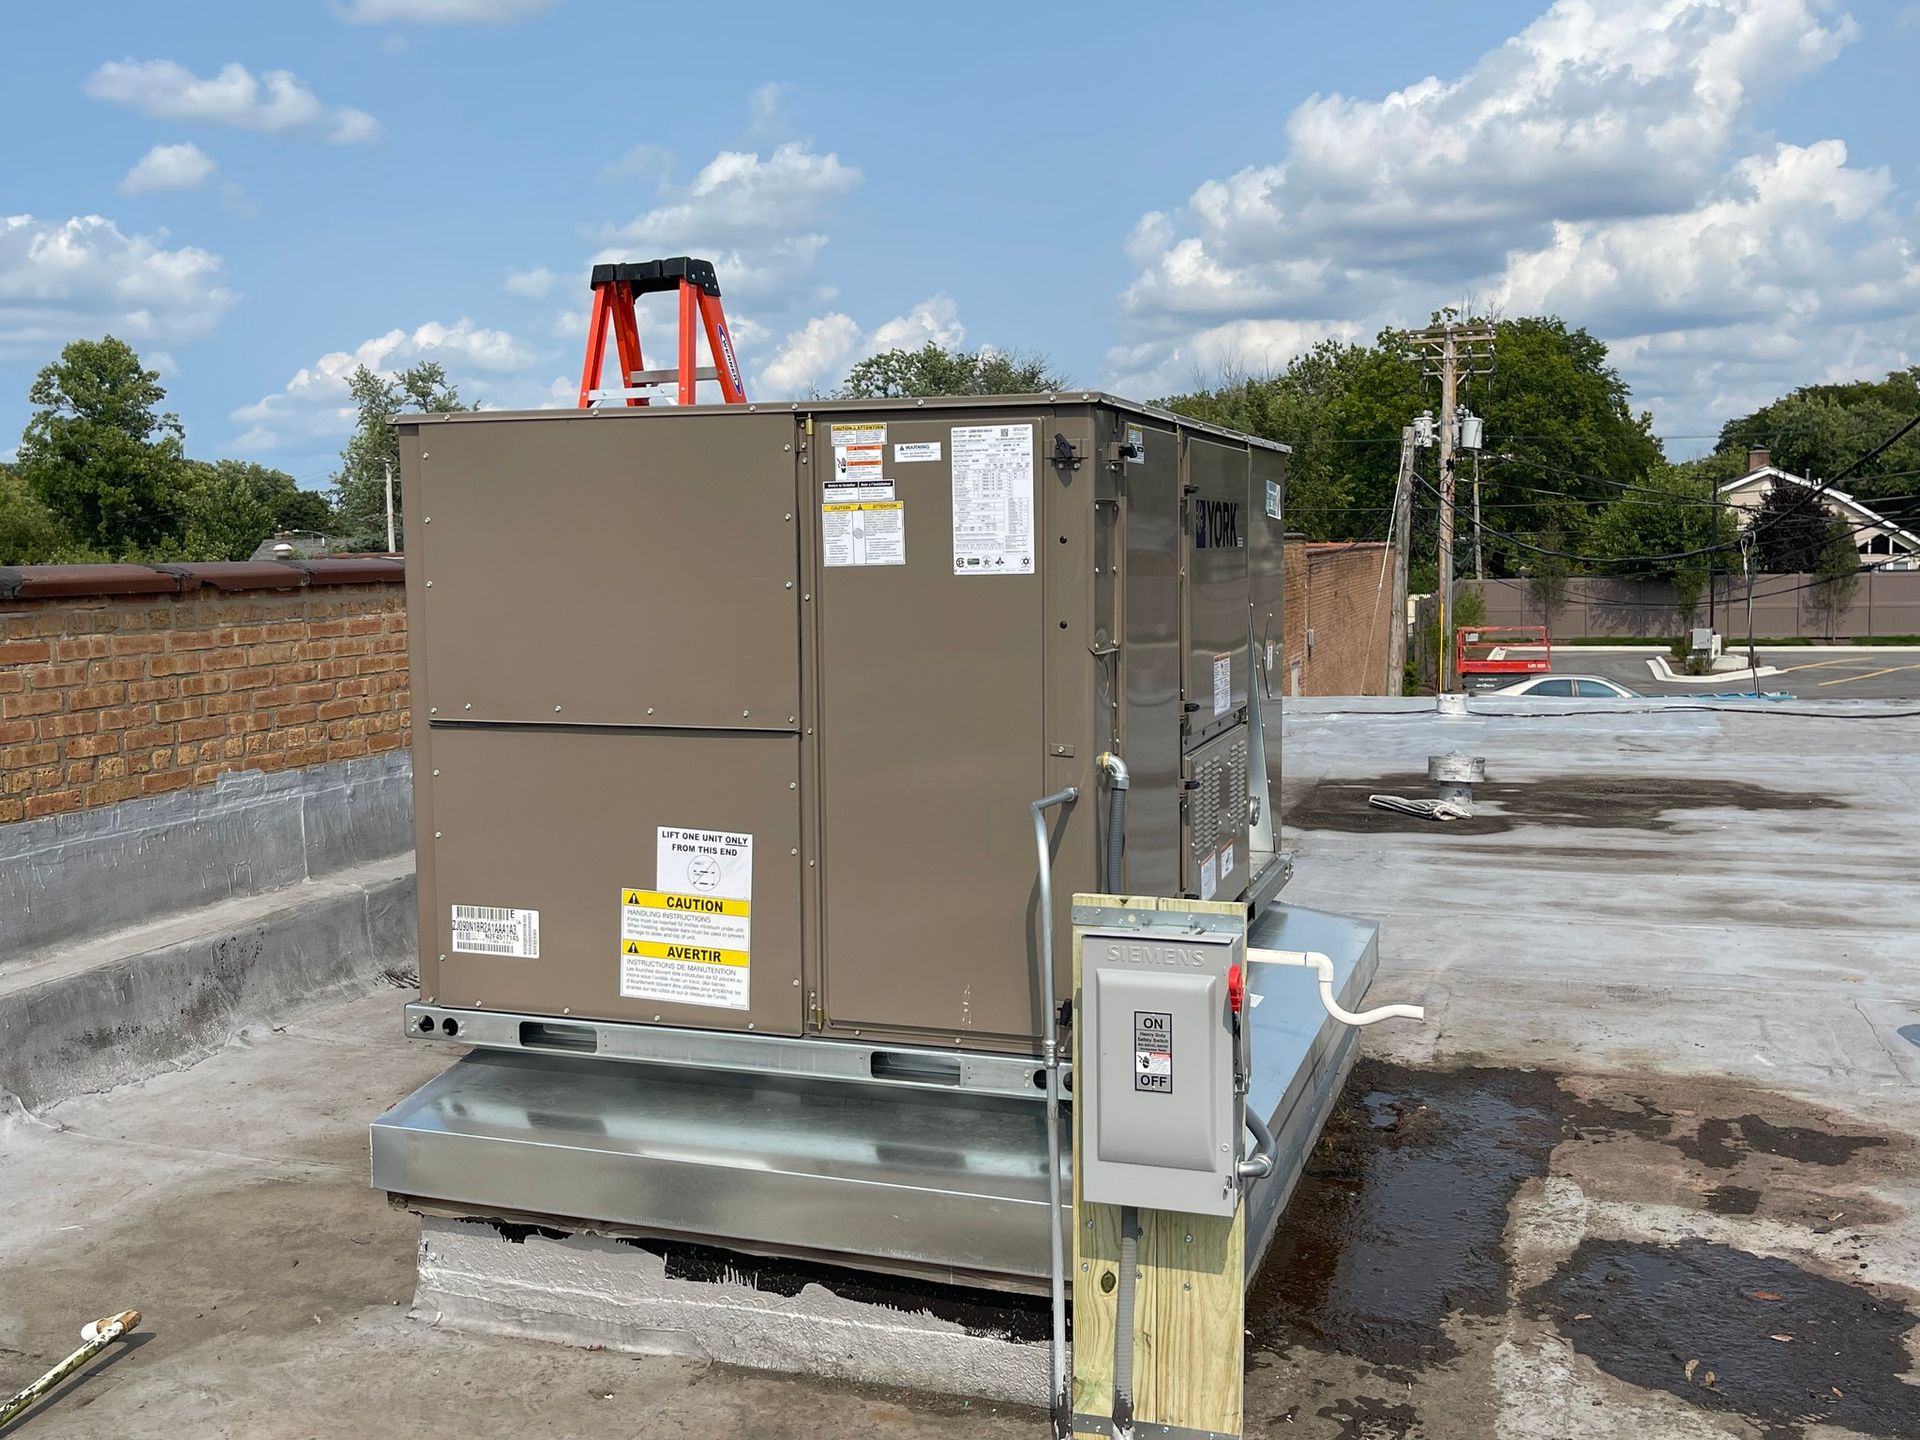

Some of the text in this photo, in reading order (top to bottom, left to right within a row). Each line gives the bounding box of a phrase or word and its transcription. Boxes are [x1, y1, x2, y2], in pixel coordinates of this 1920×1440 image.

[1207, 501, 1237, 548] YORK
[726, 836, 748, 844] ONLY
[672, 844, 695, 852] FROM
[698, 846, 717, 854] THIS
[667, 896, 723, 912] CAUTION
[511, 910, 515, 918] E
[627, 909, 711, 923] HANDLING INSTRUCTIONS
[667, 946, 721, 962] AVERTIR
[1108, 944, 1205, 967] SIEMENS
[627, 958, 675, 970] INSTRUCTIONS
[688, 965, 736, 976] MANUTENTION
[1144, 1018, 1163, 1029] ON
[1141, 1075, 1167, 1087] OFF
